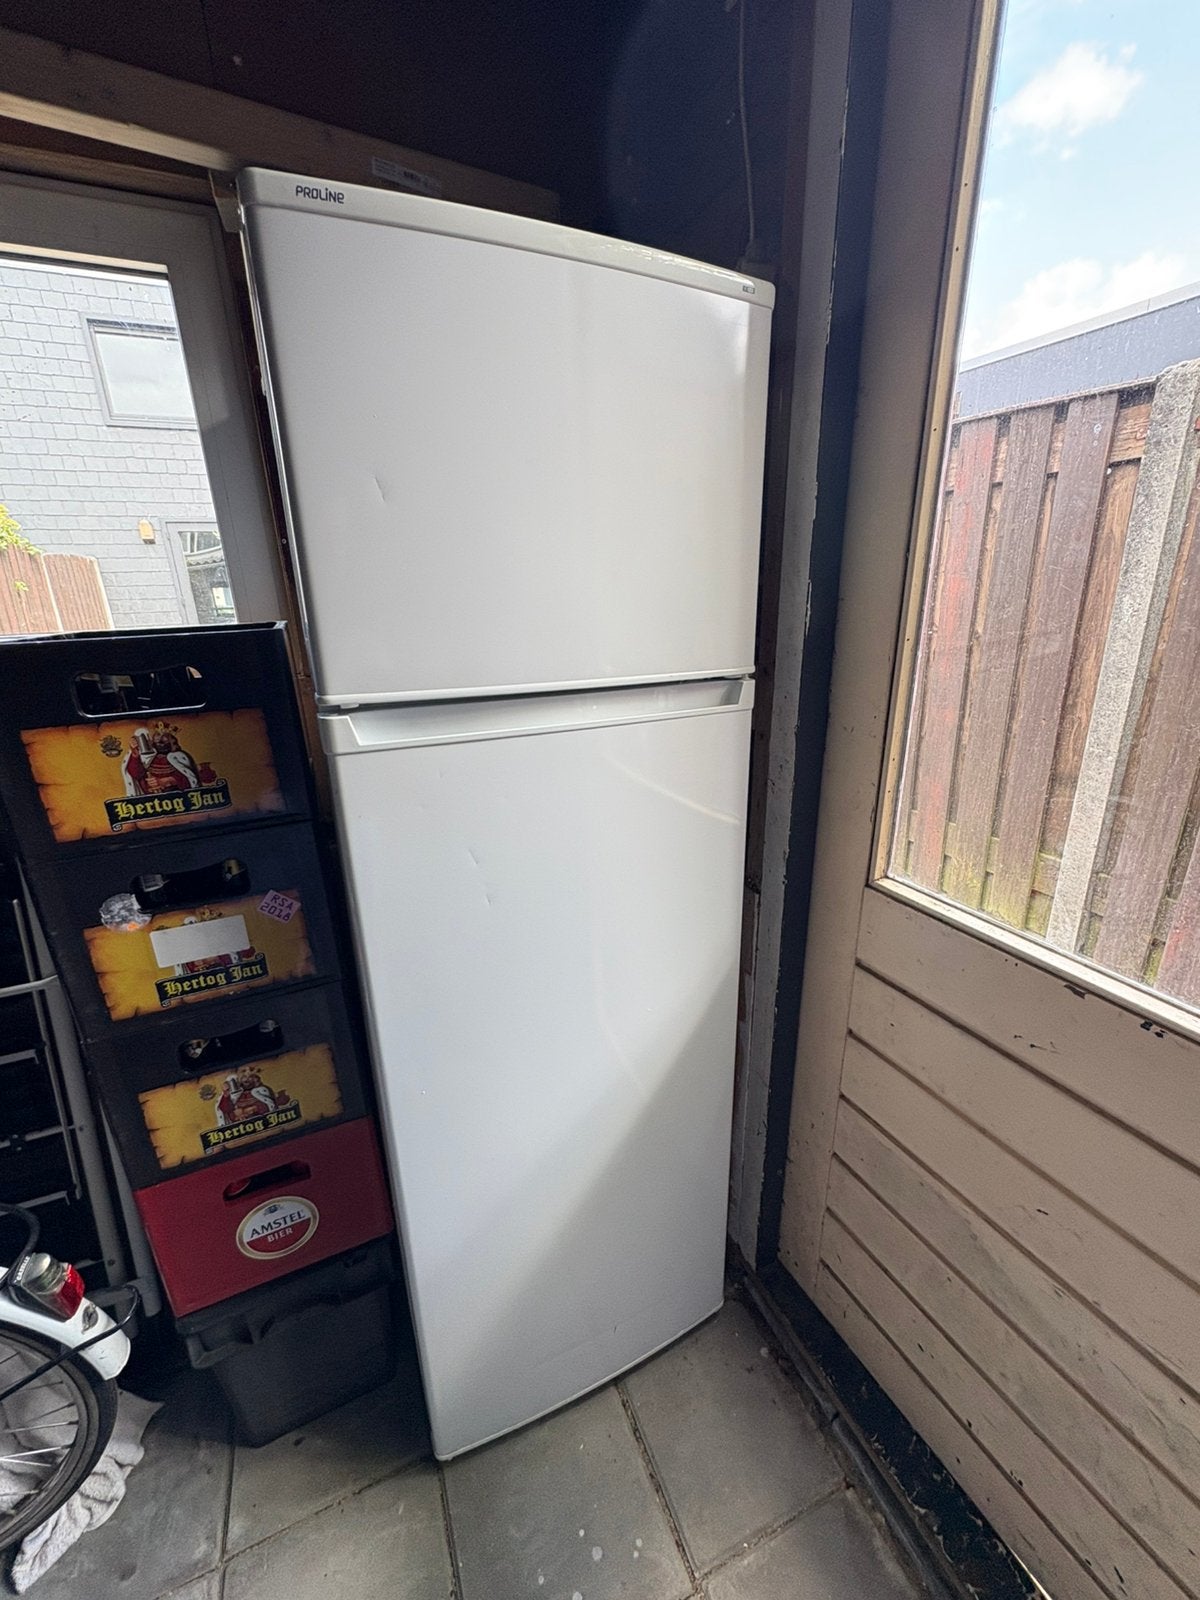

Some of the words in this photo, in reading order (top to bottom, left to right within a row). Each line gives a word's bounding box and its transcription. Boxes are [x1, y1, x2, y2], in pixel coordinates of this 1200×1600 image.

[113, 797, 186, 820] Hertog
[187, 791, 225, 811] Jan
[270, 894, 294, 911] RSA
[163, 971, 227, 997] Hertog
[229, 964, 263, 982] Jan
[206, 1119, 265, 1146] Hertog
[266, 1109, 297, 1128] Jan
[250, 1210, 306, 1239] AMSTEL
[266, 1227, 294, 1243] BIER
